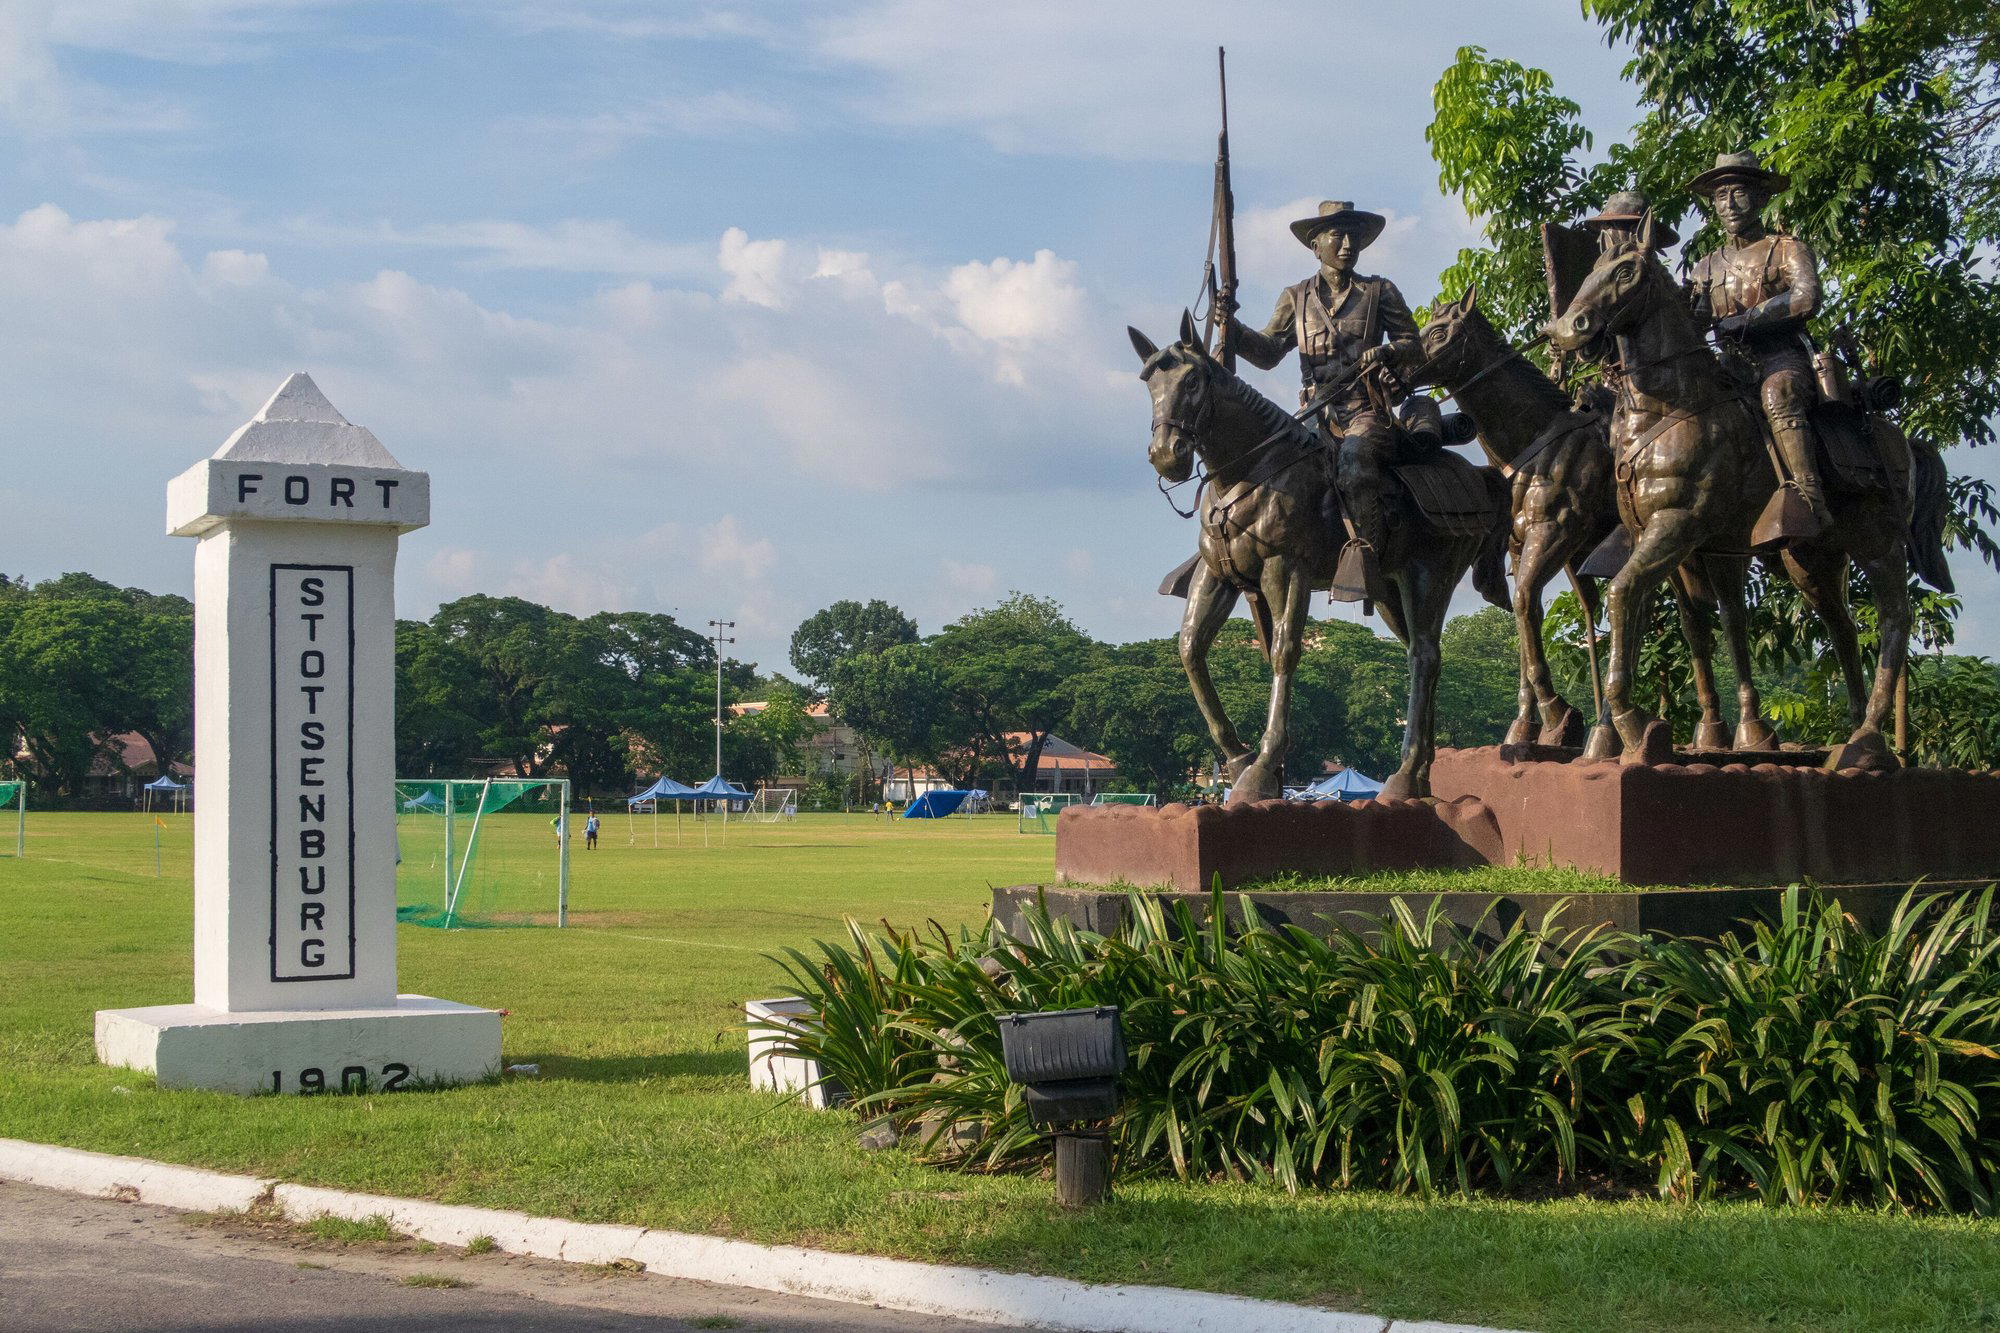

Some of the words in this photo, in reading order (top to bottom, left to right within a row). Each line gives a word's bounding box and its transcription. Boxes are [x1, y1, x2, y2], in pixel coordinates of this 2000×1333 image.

[238, 474, 399, 509] FORT
[299, 577, 326, 968] STOTSENBURG
[272, 1063, 410, 1094] 1902
